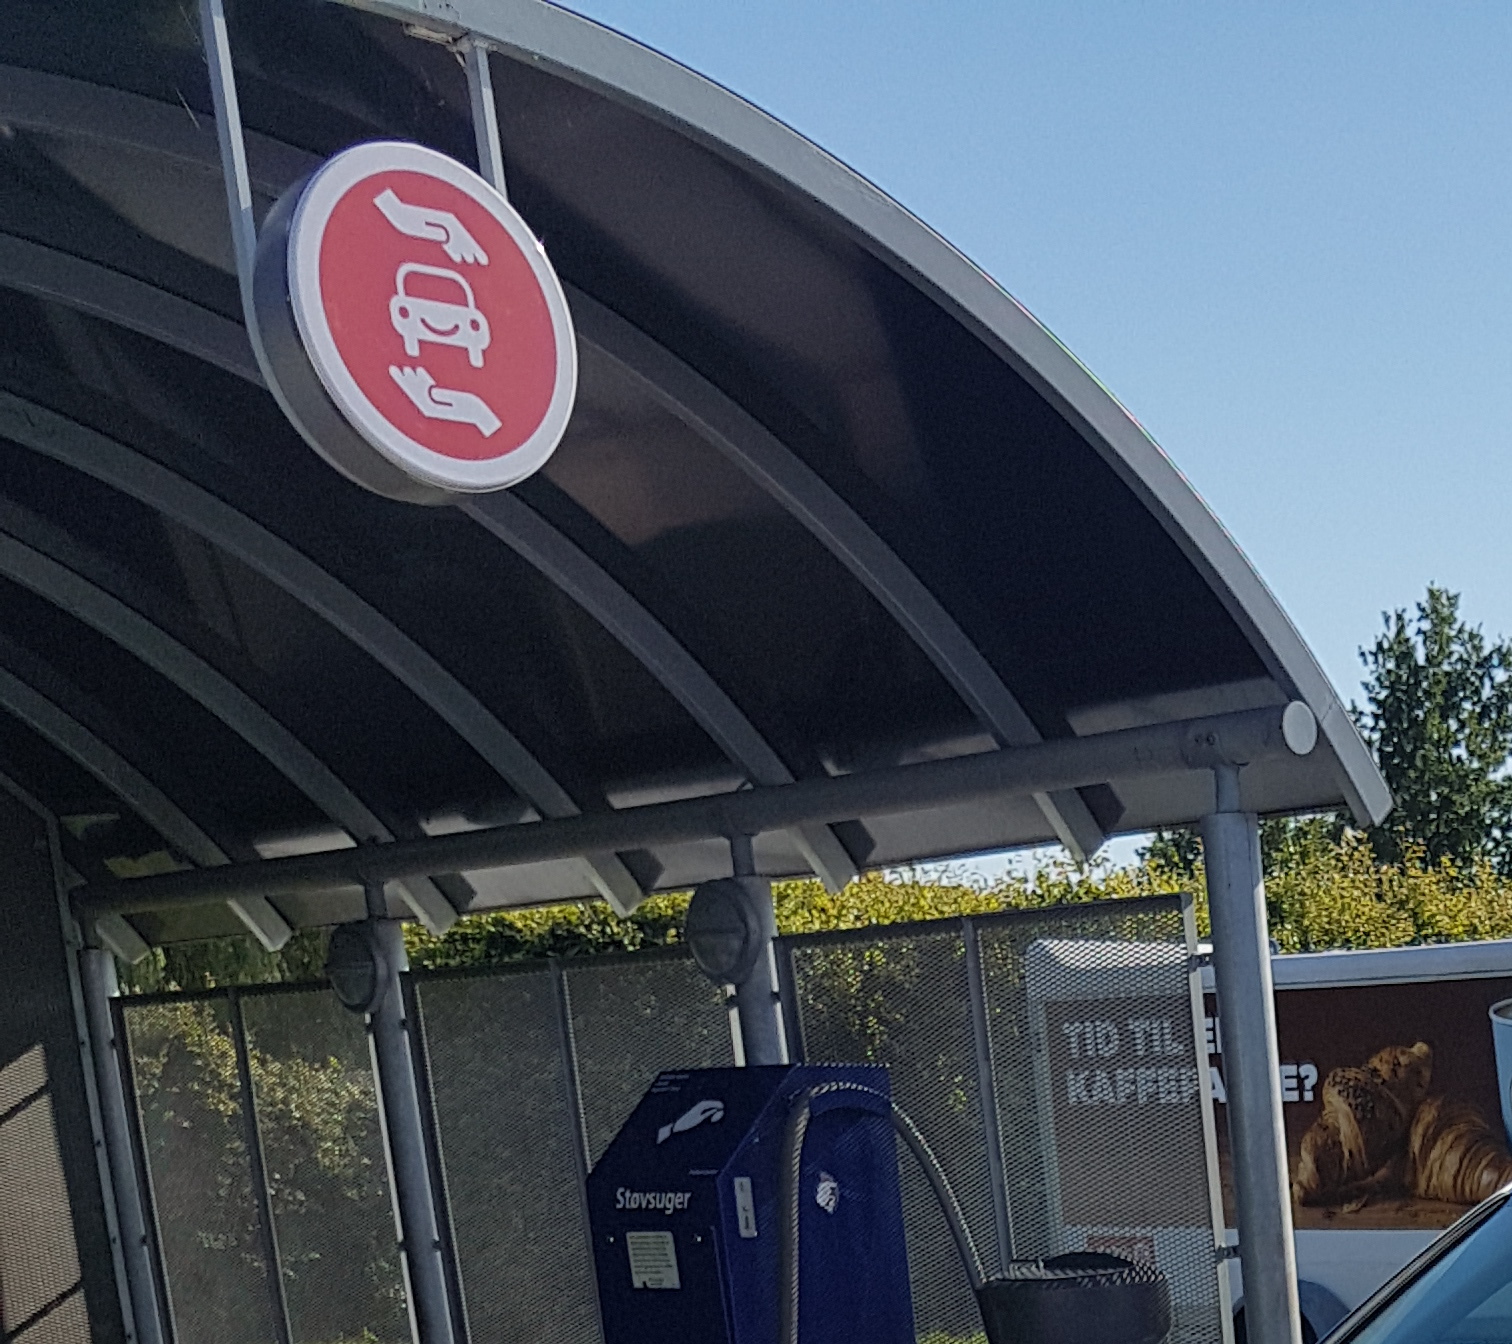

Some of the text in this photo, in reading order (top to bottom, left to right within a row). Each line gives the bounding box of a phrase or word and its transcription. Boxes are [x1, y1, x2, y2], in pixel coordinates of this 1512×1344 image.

[1062, 1020, 1120, 1057] TID
[1127, 1018, 1184, 1056] TIL
[615, 1187, 692, 1215] Støvsuger
